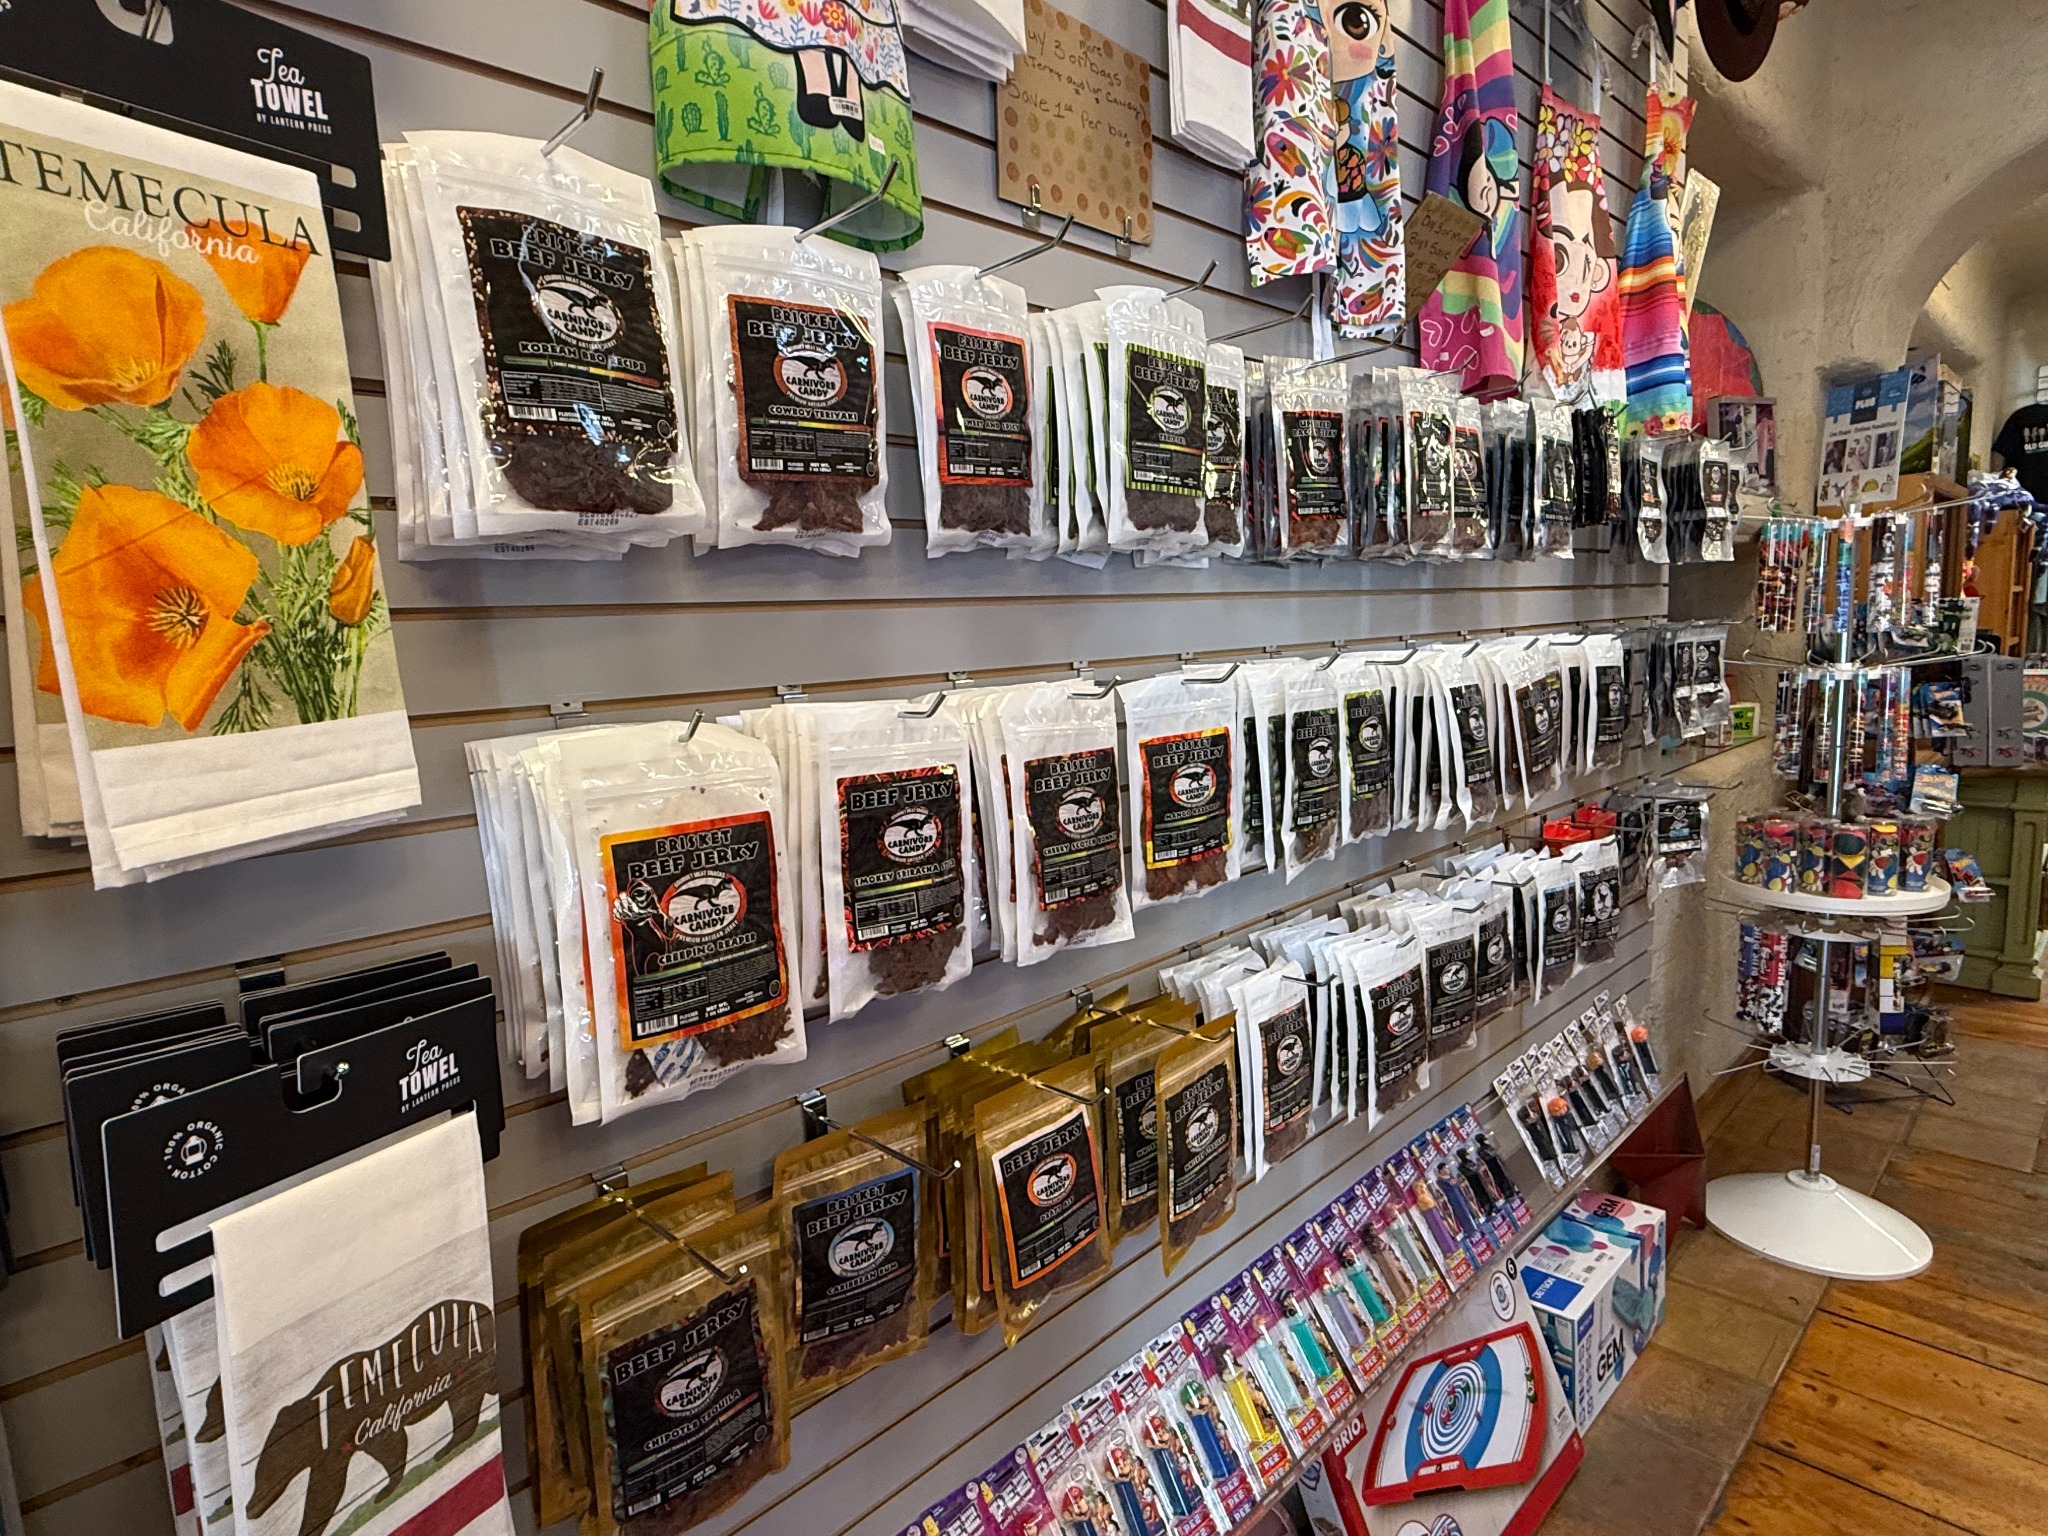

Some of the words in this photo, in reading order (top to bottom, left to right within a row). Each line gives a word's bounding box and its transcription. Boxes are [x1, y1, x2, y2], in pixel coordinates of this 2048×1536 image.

[1027, 30, 1046, 56] uy
[1054, 40, 1065, 59] 3
[256, 47, 306, 85] Tea
[249, 77, 329, 121] TOWEL
[270, 113, 305, 131] LANTERN
[307, 121, 333, 135] PRESS
[0, 139, 323, 257] TEMECULA
[84, 198, 260, 266] California
[522, 225, 606, 264] BRISKET
[489, 238, 556, 268] BEEF
[562, 259, 635, 291] JERKY
[547, 309, 612, 332] CARNIVORE
[563, 323, 603, 339] CANDY
[771, 307, 838, 330] BRISKET
[747, 320, 797, 340] BEEF
[804, 327, 860, 350] JERKY
[957, 334, 1004, 353] BRISKET
[519, 341, 578, 358] KOREAN
[581, 350, 607, 365] BBQ
[608, 355, 646, 372] RECIPE
[944, 345, 975, 363] BEEF
[978, 352, 1019, 369] JERKY
[786, 375, 836, 390] CARNIVORE
[1135, 365, 1163, 383] BEEF
[1167, 373, 1200, 391] JERKY
[798, 386, 828, 397] CANDY
[970, 393, 1004, 405] CARNIVORE
[768, 405, 812, 418] COWBOY
[814, 408, 858, 422] TERIYAKI
[978, 403, 1000, 411] CANDY
[985, 421, 1000, 430] AND
[1153, 754, 1185, 768] BEEF
[1188, 745, 1224, 762] JERKY
[1166, 737, 1211, 753] BRISKET
[1050, 757, 1096, 775] BRISKET
[1034, 776, 1070, 793] BEEF
[1074, 768, 1112, 786] JERKY
[1178, 784, 1210, 796] CARNIVORE
[850, 792, 899, 812] BEEF
[904, 780, 954, 802] JERKY
[1185, 792, 1205, 801] CANDY
[1063, 812, 1100, 826] CARNIVORE
[1073, 821, 1095, 831] CANDY
[1164, 809, 1191, 821] MANGO
[655, 829, 732, 856] BRISKET
[888, 835, 934, 849] CARNIVORE
[898, 844, 926, 854] CANDY
[1071, 839, 1096, 851] SCOTCH
[627, 856, 686, 880] BEEF
[691, 841, 759, 870] JERKY
[854, 871, 895, 887] SMOKEY
[896, 864, 939, 879] SRIRACHA
[675, 904, 734, 925] CARNIVORE
[689, 916, 726, 932] CANDY
[658, 943, 716, 966] CREEPING
[717, 931, 756, 953] REAPER
[406, 1038, 443, 1076] Tea
[398, 1052, 460, 1102] TOWEL
[131, 1092, 150, 1110] 00%
[400, 1103, 411, 1114] BY
[443, 1076, 461, 1093] PRESS
[1125, 1088, 1151, 1109] BEEF
[1175, 1099, 1195, 1123] BEEF
[1197, 1078, 1224, 1105] JERKY
[187, 1121, 224, 1151] ORGANIC
[1459, 1115, 1478, 1139] PEZ
[164, 1132, 183, 1160] 100%
[1003, 1144, 1039, 1177] BEEF
[1042, 1119, 1084, 1154] JERKY
[1439, 1130, 1457, 1155] PEZ
[171, 1154, 218, 1179] COTTON
[1419, 1144, 1438, 1169] PEZ
[1036, 1173, 1070, 1196] CARNIVORE
[1394, 1162, 1415, 1188] PEZ
[826, 1183, 886, 1214] BRISKET
[1045, 1182, 1067, 1198] CANDY
[1367, 1180, 1389, 1210] PEZ
[806, 1212, 851, 1238] BEEF
[853, 1189, 907, 1219] JERKY
[1344, 1198, 1368, 1229] PEZ
[1592, 1198, 1620, 1219] GEM
[1320, 1217, 1345, 1249] PEZ
[839, 1242, 884, 1265] CARNIVORE
[849, 1253, 877, 1268] CANDY
[1294, 1237, 1320, 1271] PEZ
[826, 1271, 877, 1296] CARIBBEAN
[878, 1262, 899, 1276] RUM
[1261, 1259, 1288, 1297] PEZ
[1229, 1288, 1258, 1325] PEZ
[614, 1341, 676, 1385] BEEF
[683, 1297, 748, 1351] JERKY
[1193, 1312, 1228, 1353] PEZ
[1388, 1330, 1402, 1346] PEZ
[1154, 1344, 1187, 1385] PEZ
[1596, 1327, 1624, 1383] GEM
[311, 1302, 484, 1451] TEMECULA
[665, 1371, 718, 1407] CARNIVORE
[679, 1386, 712, 1409] CANDY
[1330, 1386, 1345, 1403] PEZ
[354, 1371, 454, 1447] California
[644, 1419, 700, 1451] CHIPOTLE
[700, 1389, 742, 1424] TEQUILA
[1077, 1398, 1118, 1439] PEZ
[1301, 1417, 1319, 1436] PEZ
[1331, 1418, 1362, 1458] BRIO
[1035, 1432, 1075, 1485] PEZ
[1261, 1452, 1284, 1471] PEZ
[1221, 1479, 1240, 1497] PEZ
[1269, 1468, 1287, 1486] PEZ
[988, 1467, 1032, 1523] PEZ
[1227, 1492, 1246, 1508] PEZ
[1182, 1516, 1202, 1535] PEZ
[1233, 1505, 1252, 1524] PEZ
